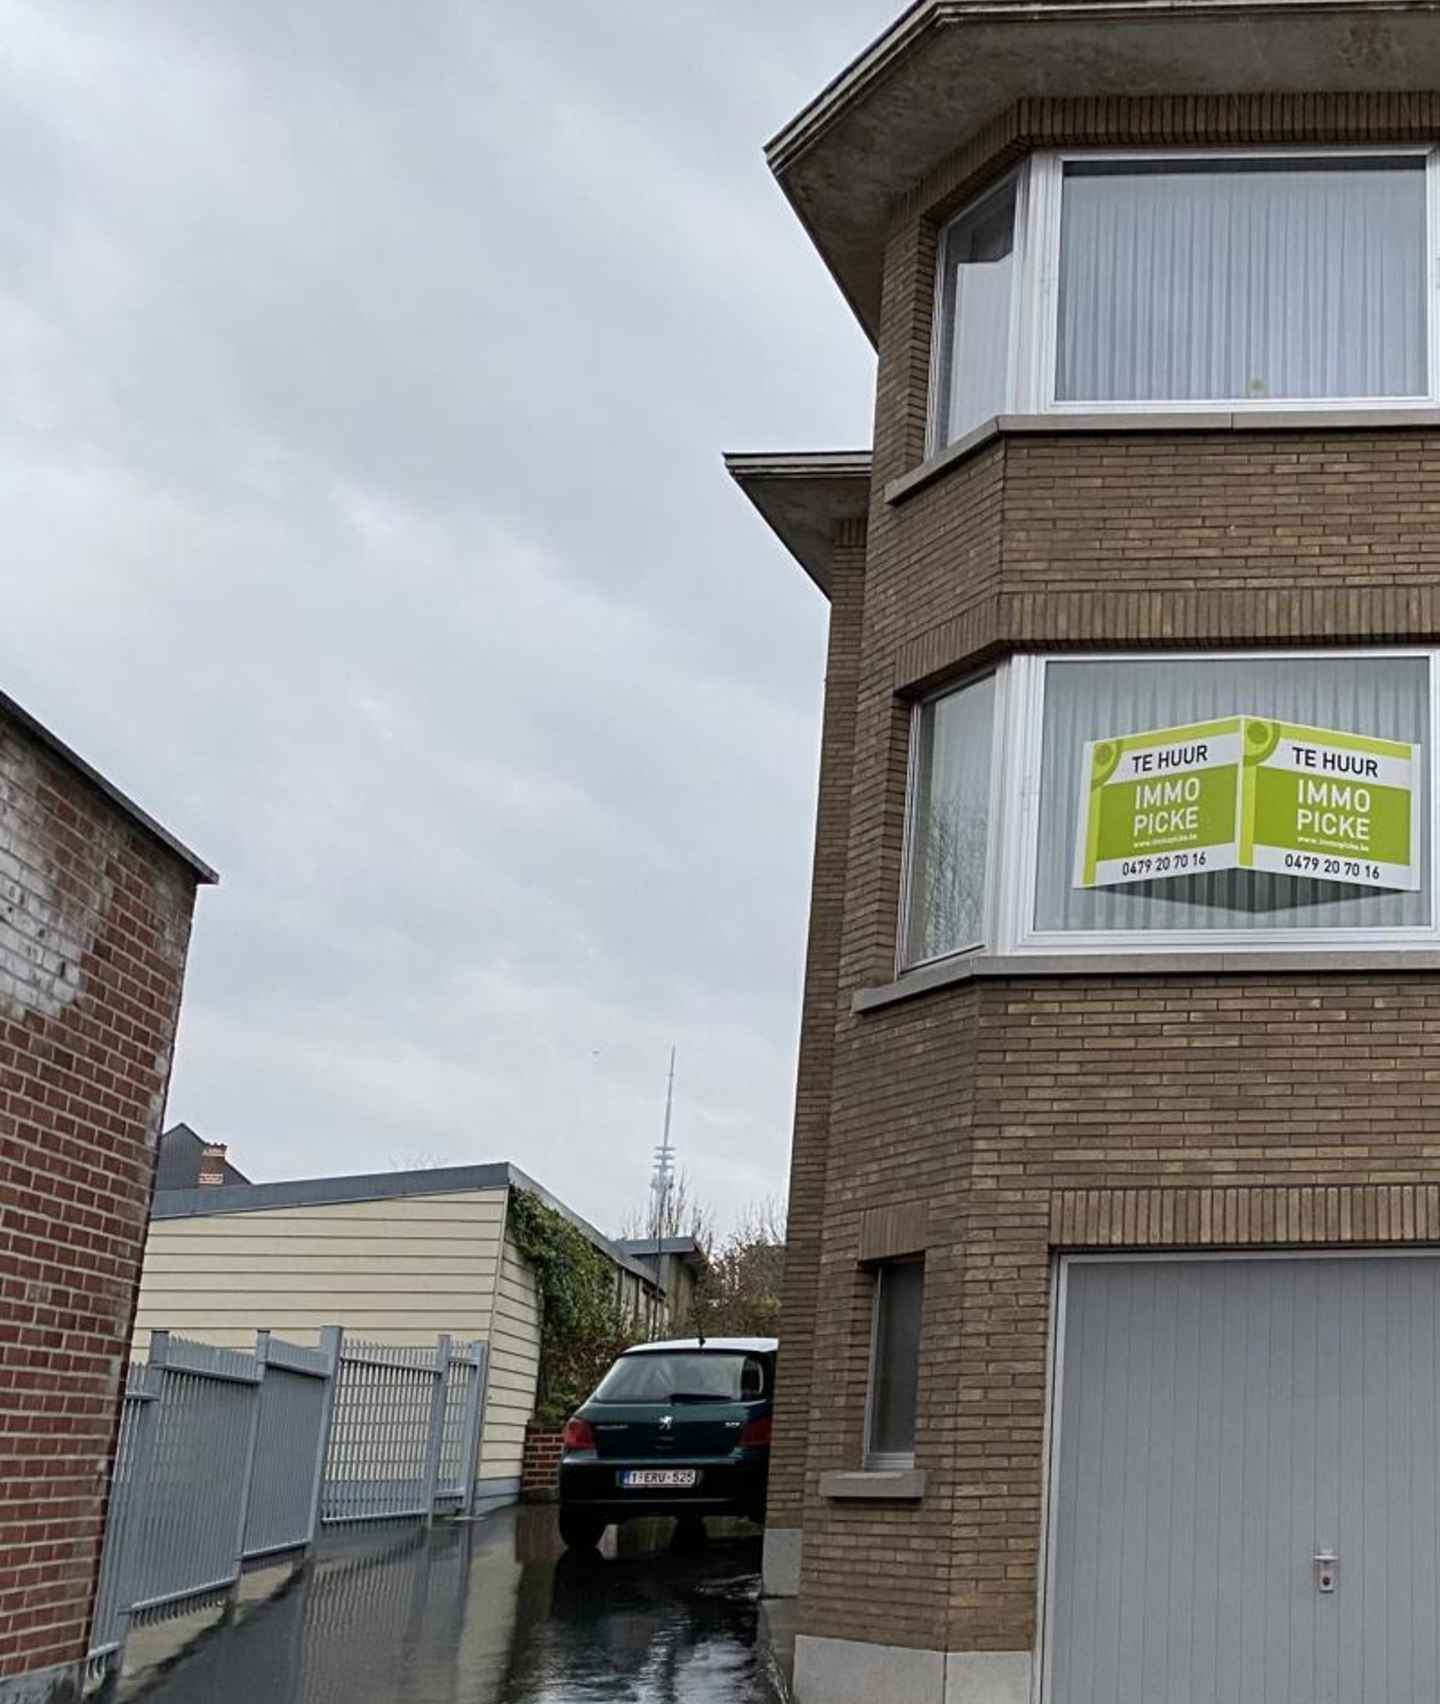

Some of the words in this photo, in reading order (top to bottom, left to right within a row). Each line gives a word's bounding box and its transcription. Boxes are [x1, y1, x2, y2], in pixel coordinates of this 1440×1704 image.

[1132, 753, 1153, 773] TE
[1158, 744, 1208, 769] HUUR
[1292, 746, 1317, 768] TE
[1322, 751, 1378, 778] HUUR
[1135, 777, 1200, 810] IMMO
[1298, 778, 1371, 813] IMMO
[1133, 805, 1199, 837] PICKE
[1296, 808, 1371, 841] PICKE
[1122, 858, 1153, 877] 0479
[1155, 856, 1171, 872] 20
[1174, 853, 1189, 870] 70
[1192, 851, 1207, 866] 16
[1284, 853, 1320, 871] 0479
[1324, 858, 1341, 874] 20
[1344, 861, 1360, 877] 70
[1365, 864, 1380, 880] 16
